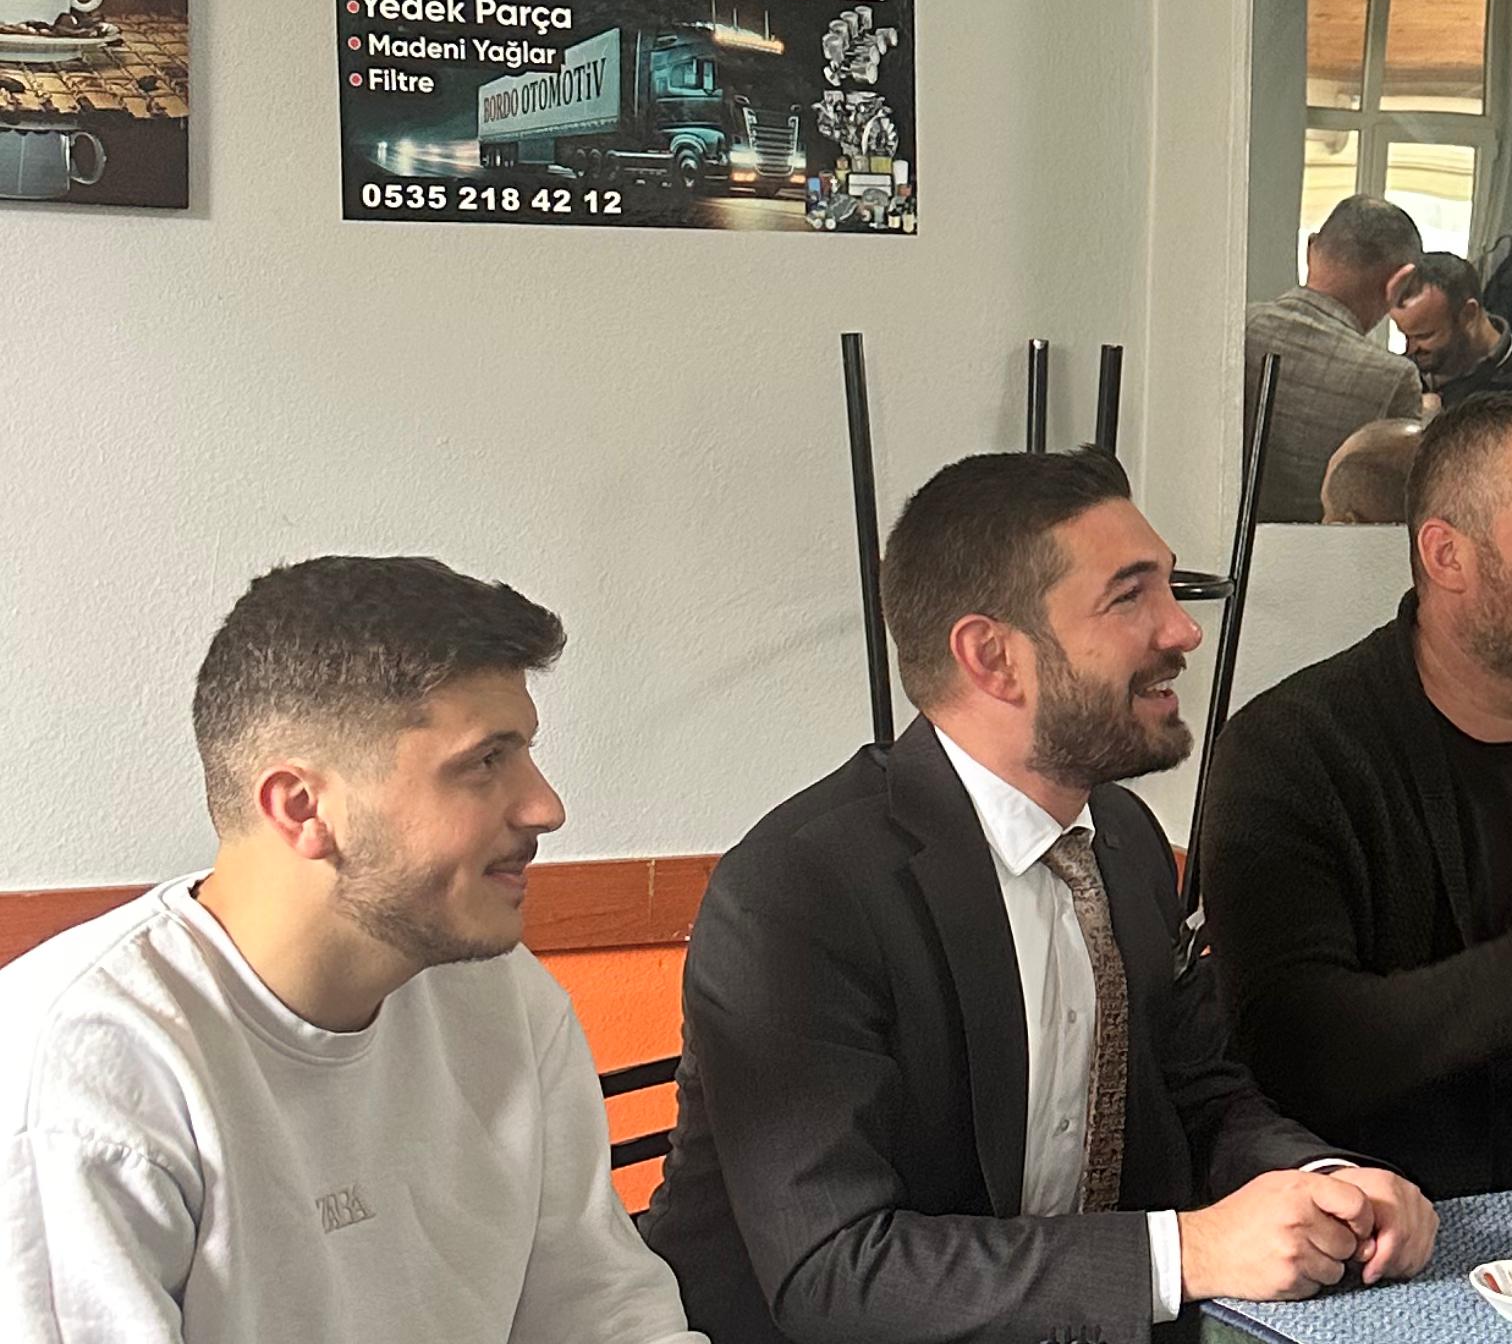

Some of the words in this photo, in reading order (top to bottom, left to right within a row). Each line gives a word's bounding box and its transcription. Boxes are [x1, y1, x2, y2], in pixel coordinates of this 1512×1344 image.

[368, 34, 467, 60] Madeni
[472, 38, 556, 68] Yağlar
[368, 69, 435, 94] Filtre
[484, 88, 519, 123] BORDO
[362, 183, 447, 209] 0535
[458, 186, 520, 212] 218
[531, 188, 572, 213] 42
[583, 190, 622, 214] 12
